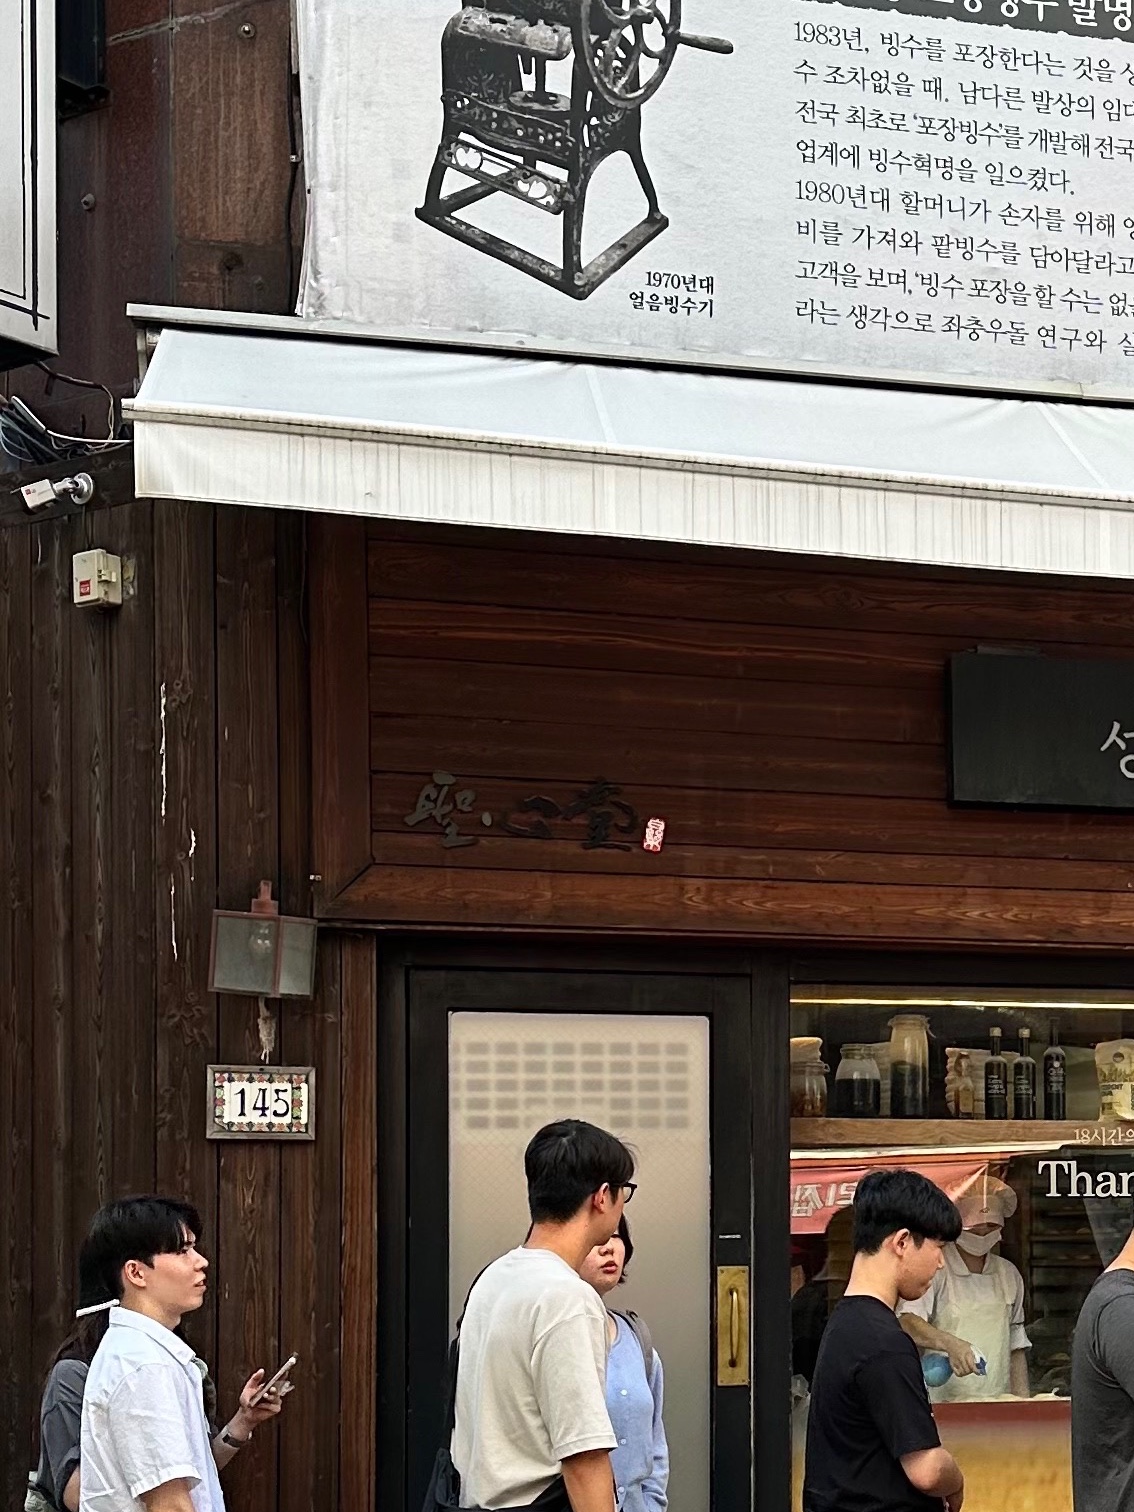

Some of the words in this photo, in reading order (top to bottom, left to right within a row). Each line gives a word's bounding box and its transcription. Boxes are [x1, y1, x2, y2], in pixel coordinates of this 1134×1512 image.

[794, 21, 870, 55] 1983년,
[880, 32, 947, 63] 빙수를
[953, 43, 1067, 78] 포장한다는
[1073, 56, 1117, 84] 것을
[793, 63, 819, 85] 수
[823, 65, 916, 98] 조차없을
[958, 81, 1026, 112] 남다른
[1031, 90, 1095, 121] 발상의
[795, 99, 841, 128] 전국
[845, 106, 911, 133] 최초로
[1028, 129, 1090, 159] 개발해
[796, 139, 860, 171] 업계에
[868, 148, 979, 184] 빙수혁명을
[985, 162, 1075, 196] 일으켰다.
[795, 180, 890, 214] 1980년대
[899, 191, 993, 225] 할머니가
[998, 202, 1066, 233] 손자를
[1073, 211, 1115, 239] 위해
[796, 218, 844, 247] 비를
[852, 225, 924, 257] 가져와
[931, 234, 1022, 266] 팥빙수를
[629, 291, 714, 318] 얼음빙수기
[645, 271, 714, 295] 1970년대
[795, 260, 863, 289] 고객을
[1060, 288, 1104, 315] 수는
[795, 298, 842, 326] 라는
[846, 304, 937, 334] 생각으로
[941, 314, 1030, 347] 좌충우돌
[1038, 325, 1108, 355] 연구와
[234, 1087, 291, 1118] 145
